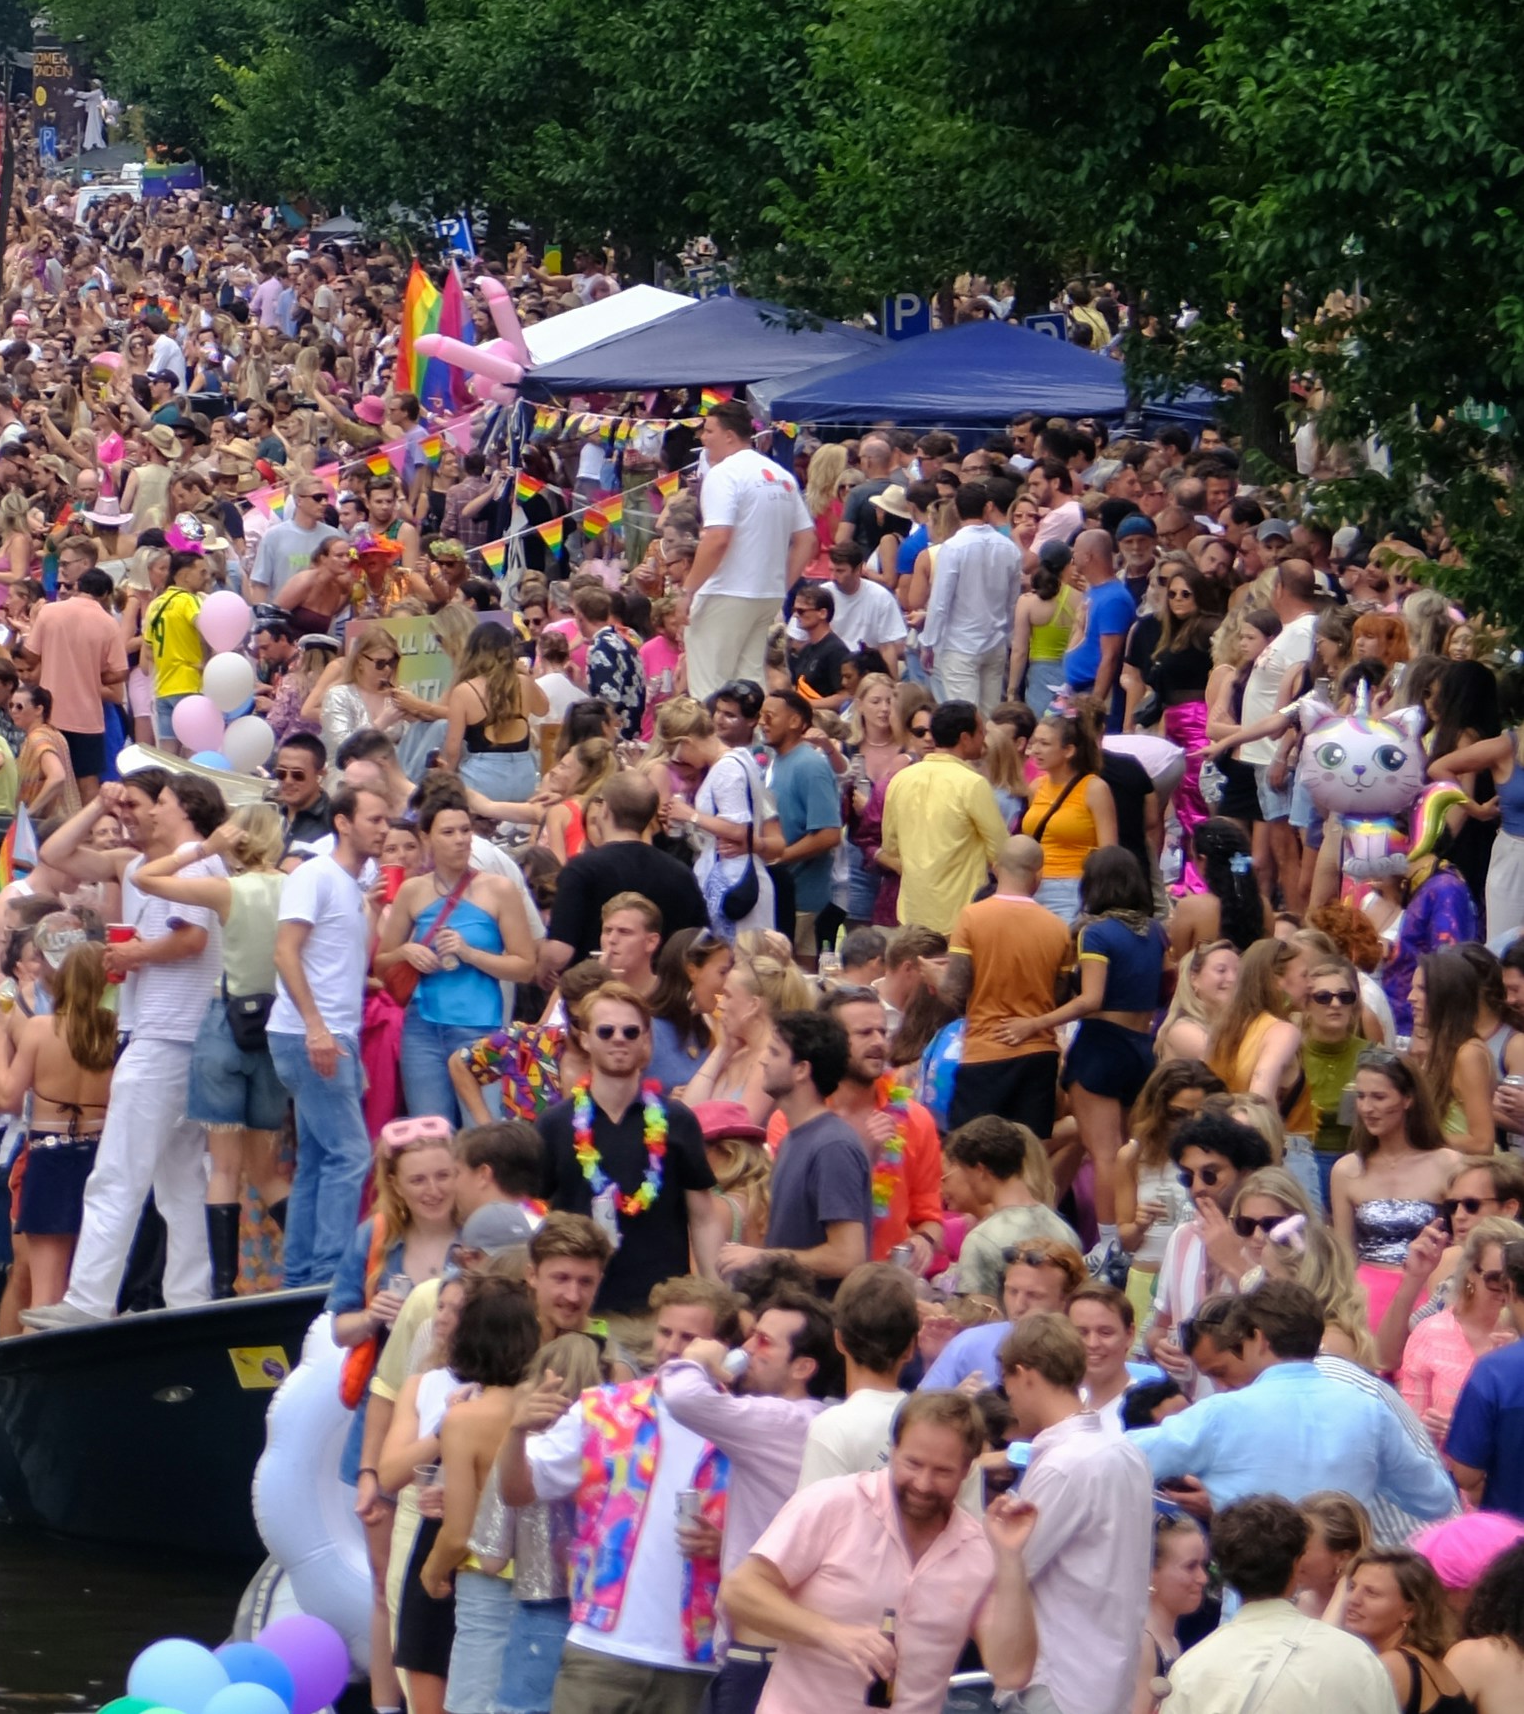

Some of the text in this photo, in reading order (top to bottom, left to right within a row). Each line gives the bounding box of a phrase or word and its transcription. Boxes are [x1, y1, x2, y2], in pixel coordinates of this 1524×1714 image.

[34, 52, 68, 64] OMER
[33, 65, 73, 77] ONDEN
[43, 130, 51, 144] P
[894, 293, 921, 331] P
